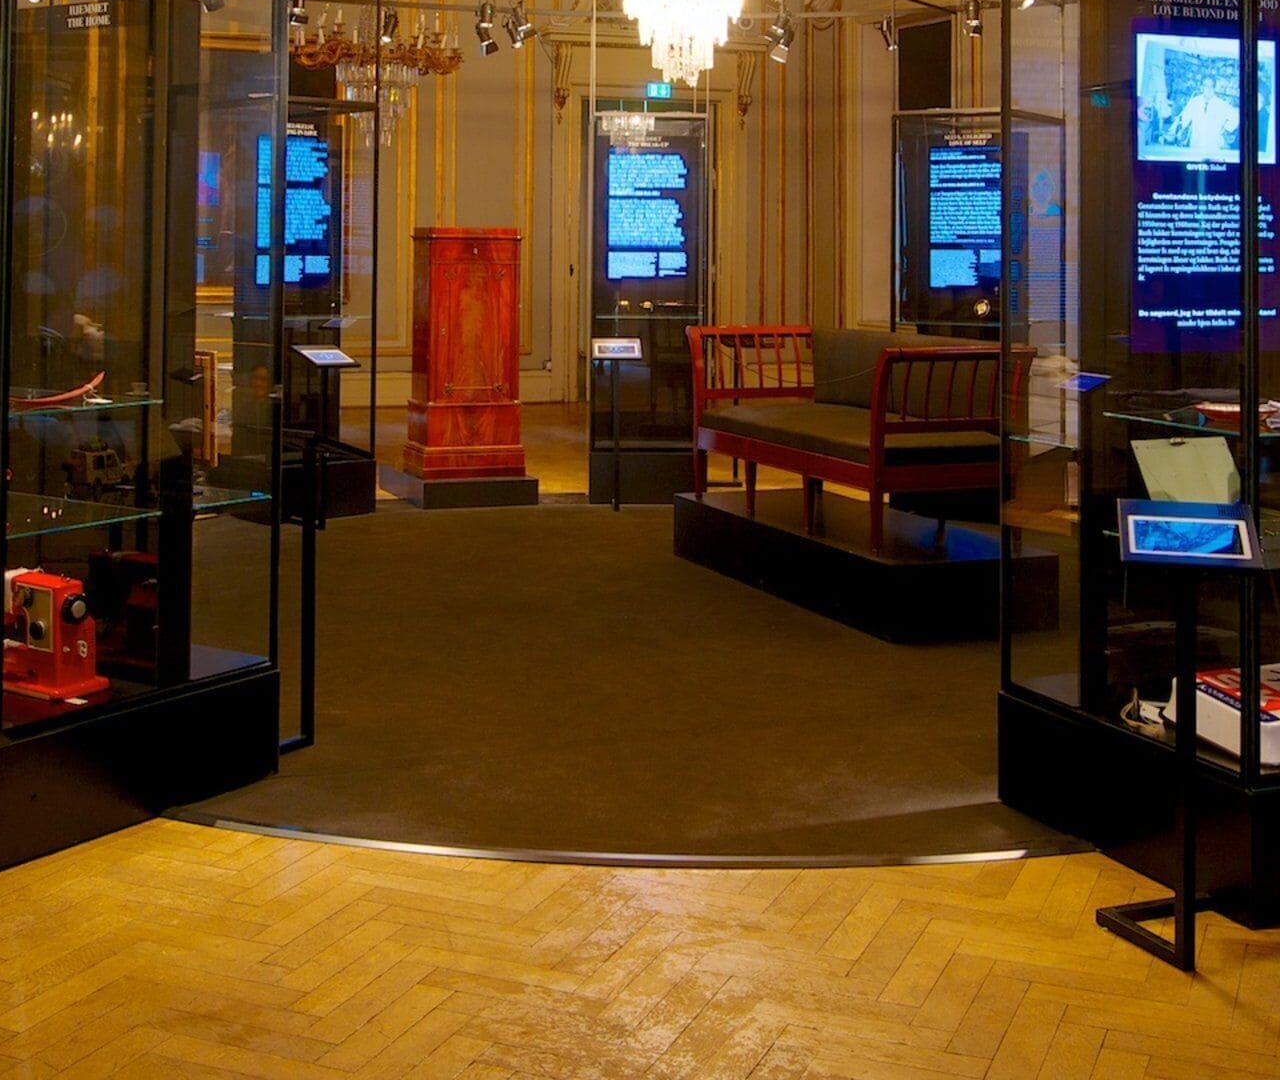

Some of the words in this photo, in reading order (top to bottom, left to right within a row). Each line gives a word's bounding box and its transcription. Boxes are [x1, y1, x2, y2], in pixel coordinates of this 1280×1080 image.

[1153, 4, 1181, 16] LOVE
[1182, 6, 1224, 19] BEYOND
[67, 17, 85, 28] THE
[85, 15, 111, 27] HOME
